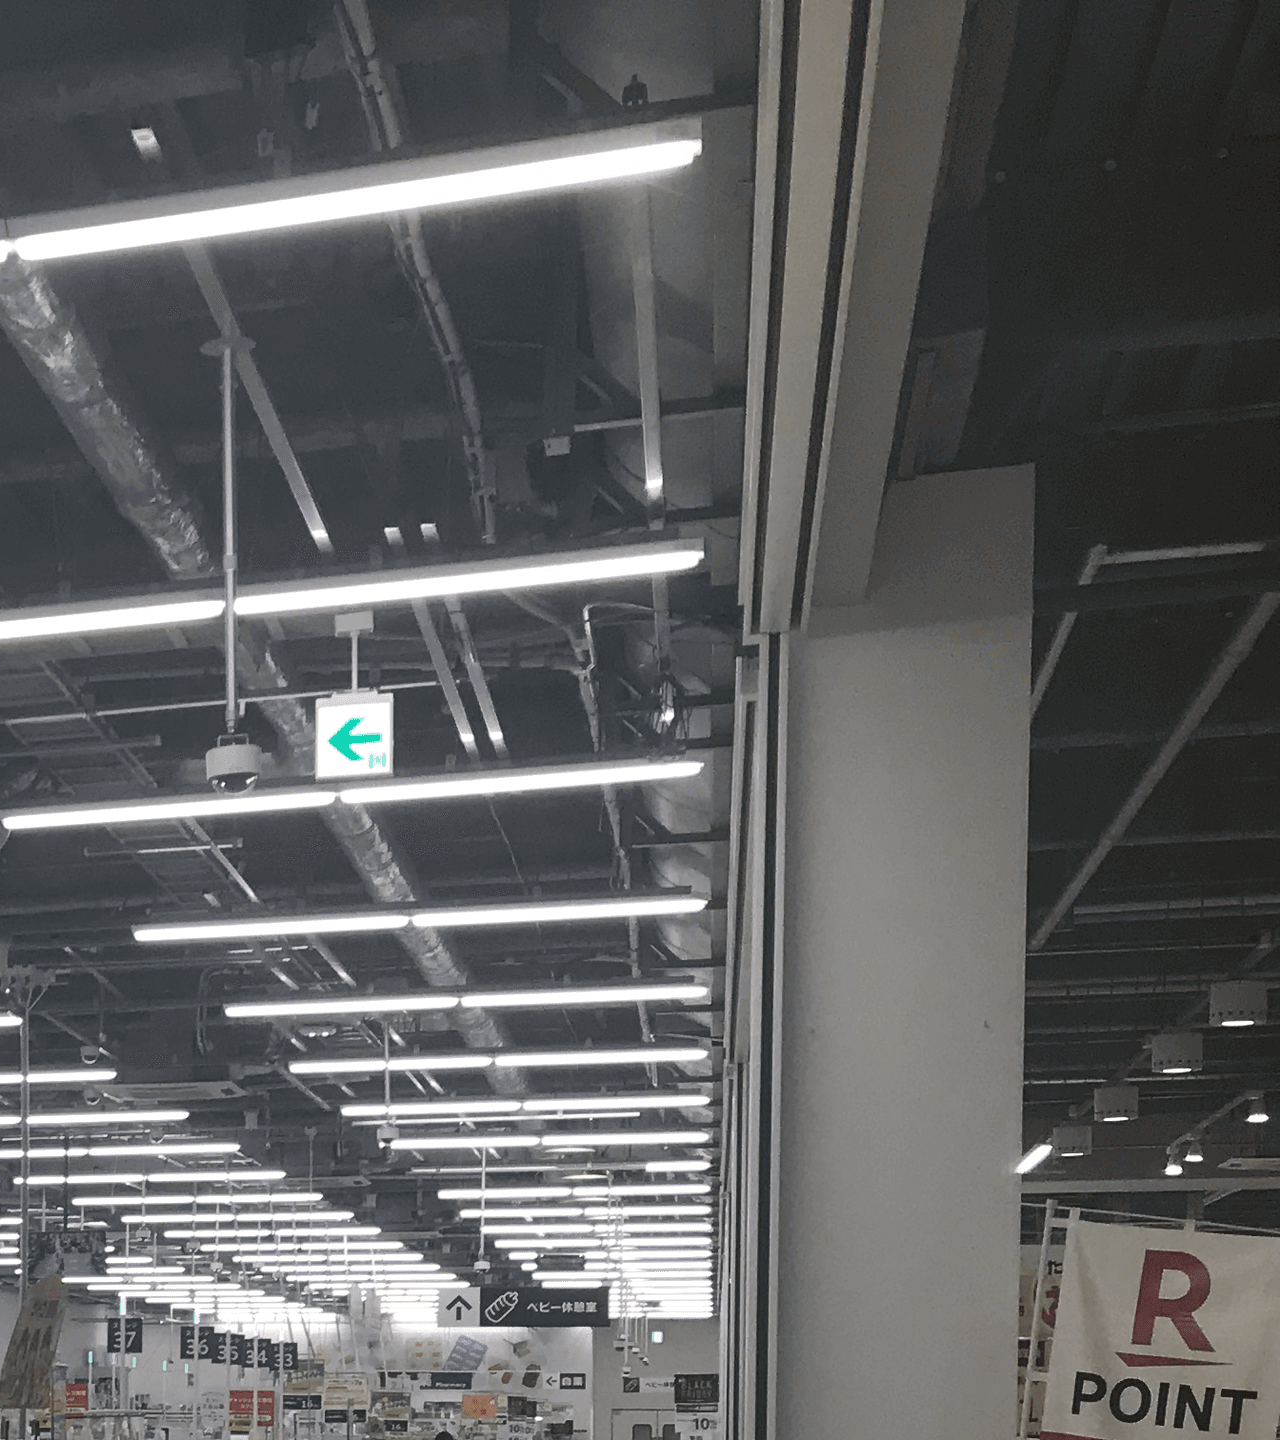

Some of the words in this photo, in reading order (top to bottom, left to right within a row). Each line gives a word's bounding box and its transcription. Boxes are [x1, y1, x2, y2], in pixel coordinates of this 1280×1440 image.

[527, 1301, 598, 1313] ベビー休憩室
[1131, 1249, 1216, 1352] R
[113, 1331, 137, 1348] 37
[186, 1338, 209, 1354] 36
[217, 1345, 239, 1361] 35
[245, 1349, 268, 1364] 34
[274, 1353, 293, 1367] 33
[681, 1380, 713, 1390] BLACK
[1071, 1371, 1258, 1435] POINT
